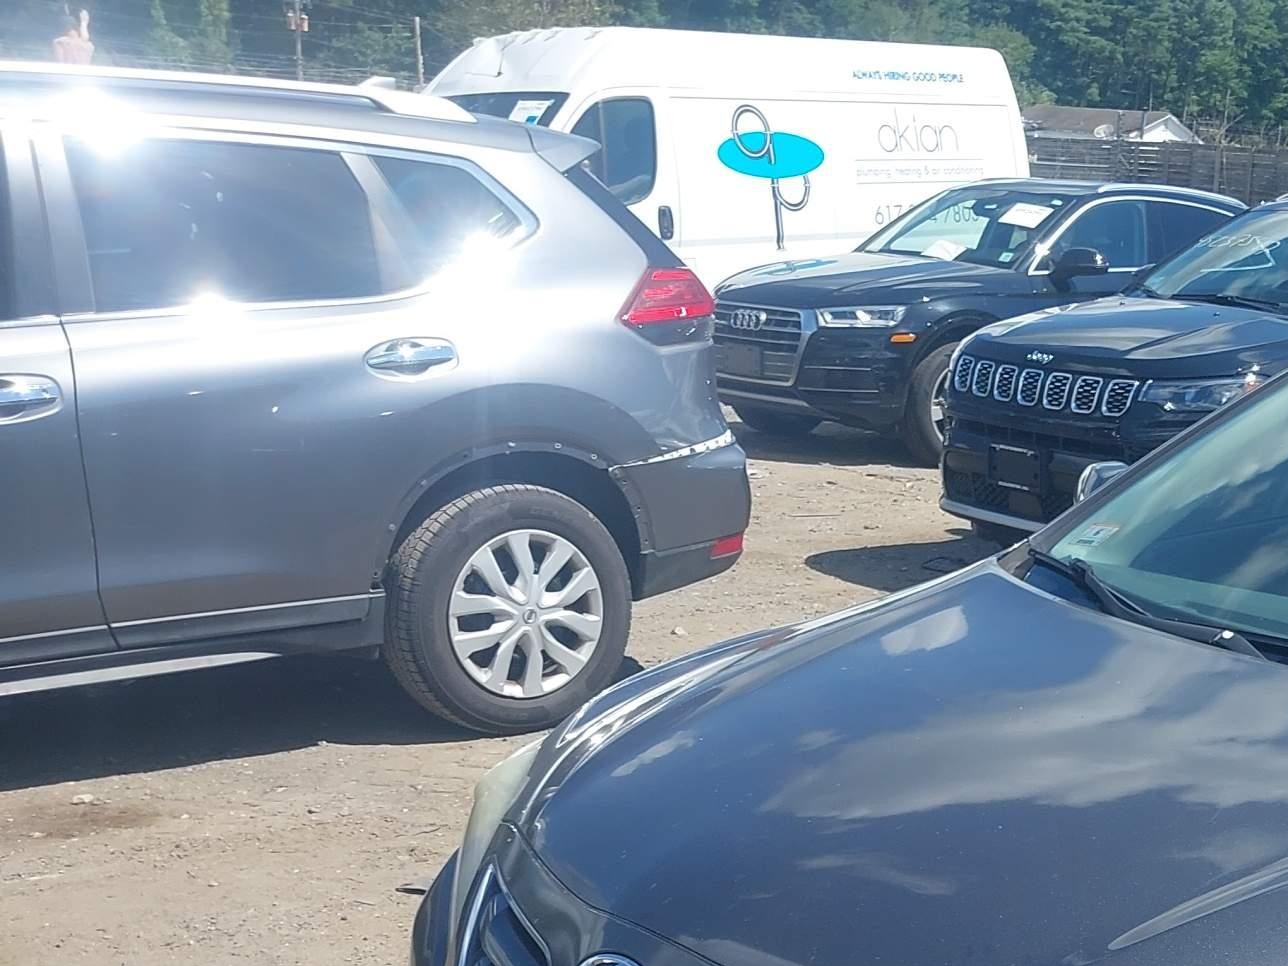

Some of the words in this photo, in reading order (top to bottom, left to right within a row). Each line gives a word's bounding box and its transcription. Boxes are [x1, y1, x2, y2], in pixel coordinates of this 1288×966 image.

[852, 70, 882, 80] ALWAYS
[912, 72, 937, 82] GOOD
[938, 73, 964, 83] PEOPLE
[877, 106, 959, 153] akian
